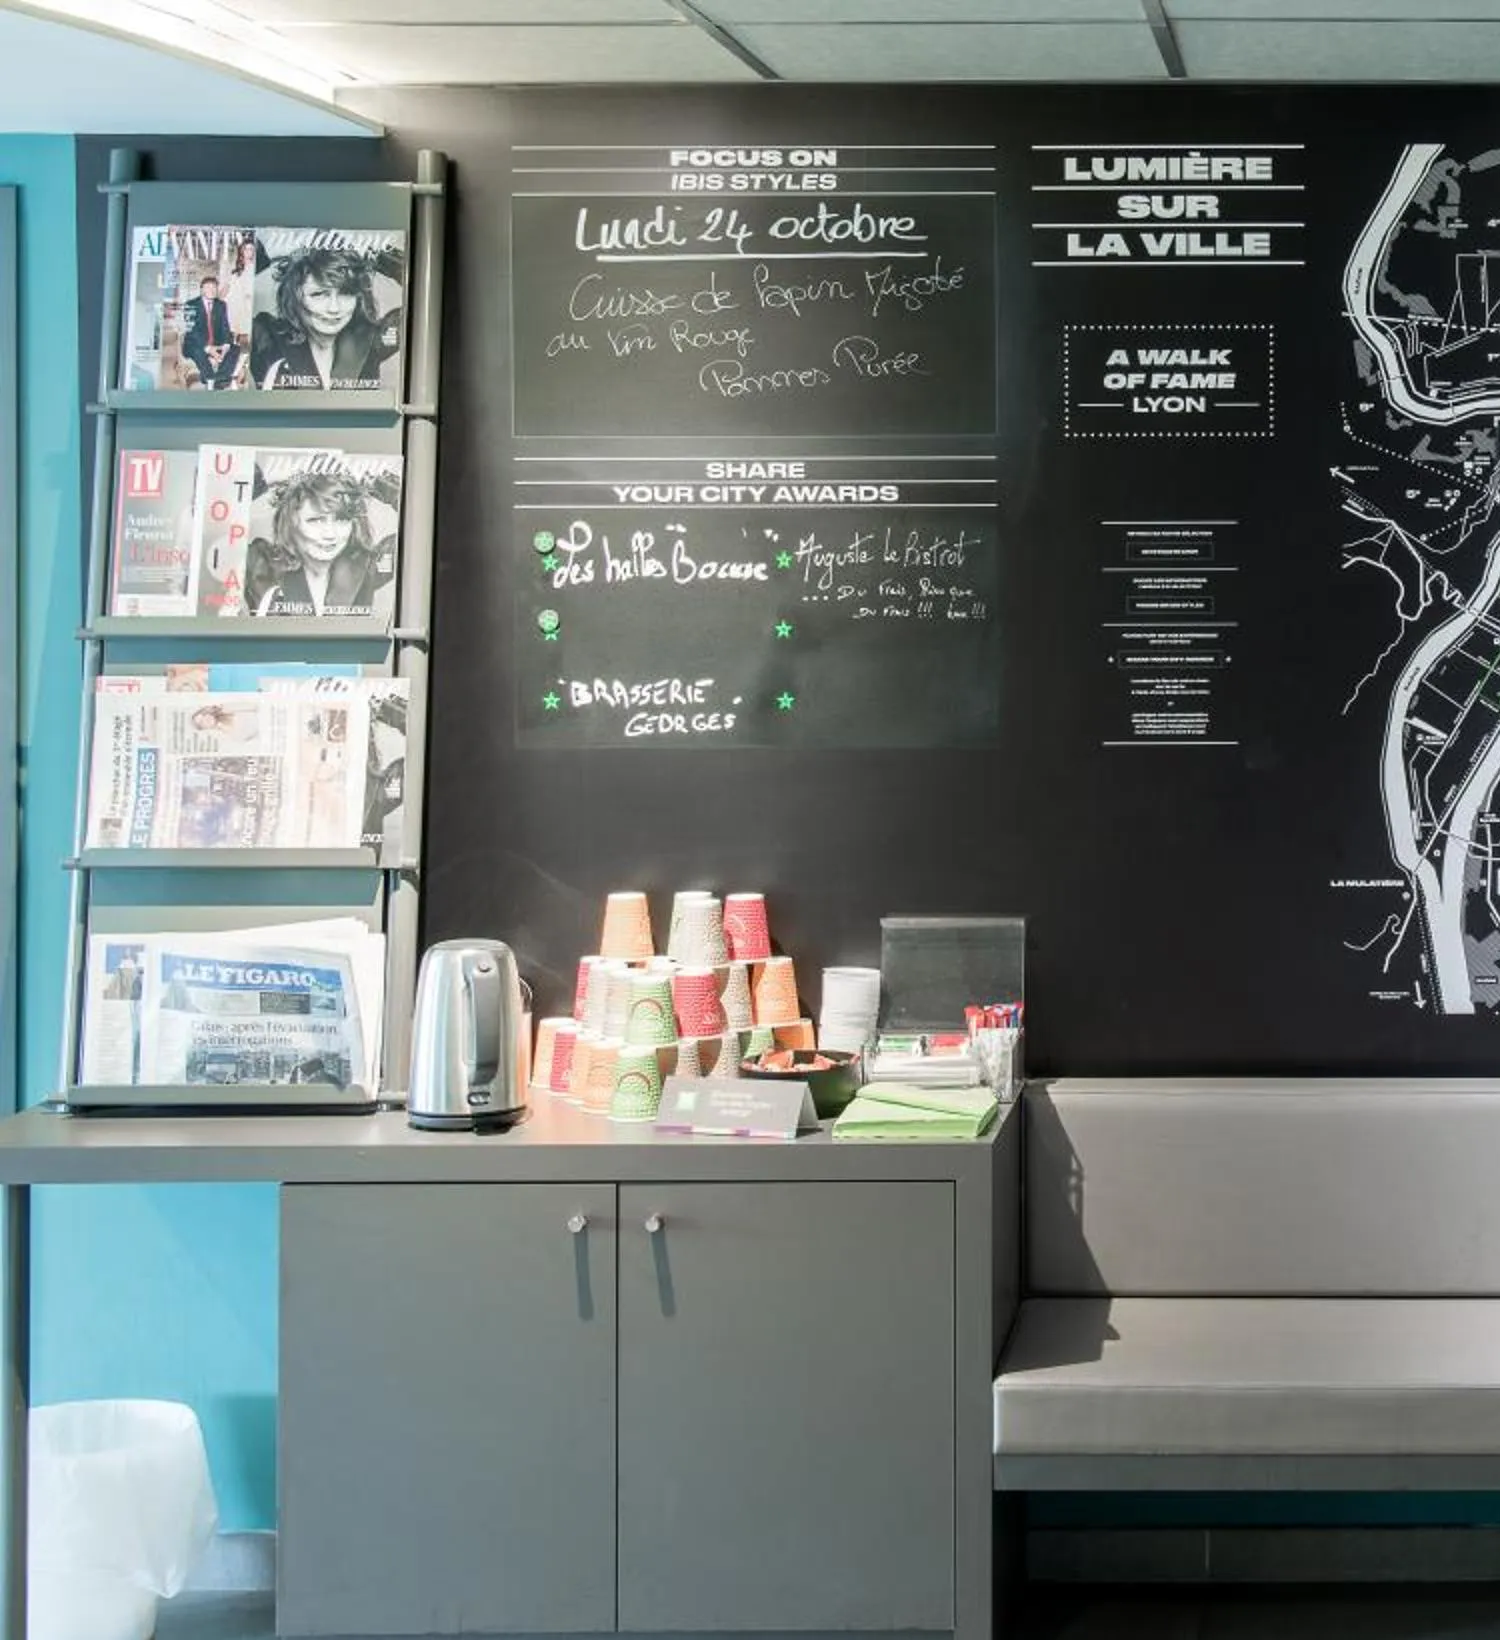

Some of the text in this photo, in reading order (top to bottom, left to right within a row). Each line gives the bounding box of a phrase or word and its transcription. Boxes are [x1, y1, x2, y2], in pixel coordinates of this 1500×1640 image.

[670, 150, 837, 167] FOCUS ON
[1064, 150, 1273, 181] LUMIÈRE
[671, 173, 837, 191] IBIS STYLES
[1117, 194, 1219, 219] SUR
[575, 201, 929, 255] Lundi 24 octobre
[1067, 232, 1271, 257] LA VILLE
[1105, 349, 1233, 366] A WALK
[1103, 372, 1237, 390] OF FAME
[1133, 396, 1206, 413] LYON
[128, 458, 163, 492] TV
[704, 462, 806, 479] SHARE
[612, 484, 900, 503] YOUR CITY AWARDS
[571, 677, 715, 710] BRASSERIE
[624, 711, 737, 737] GEORGES
[219, 966, 317, 988] FIGARO
